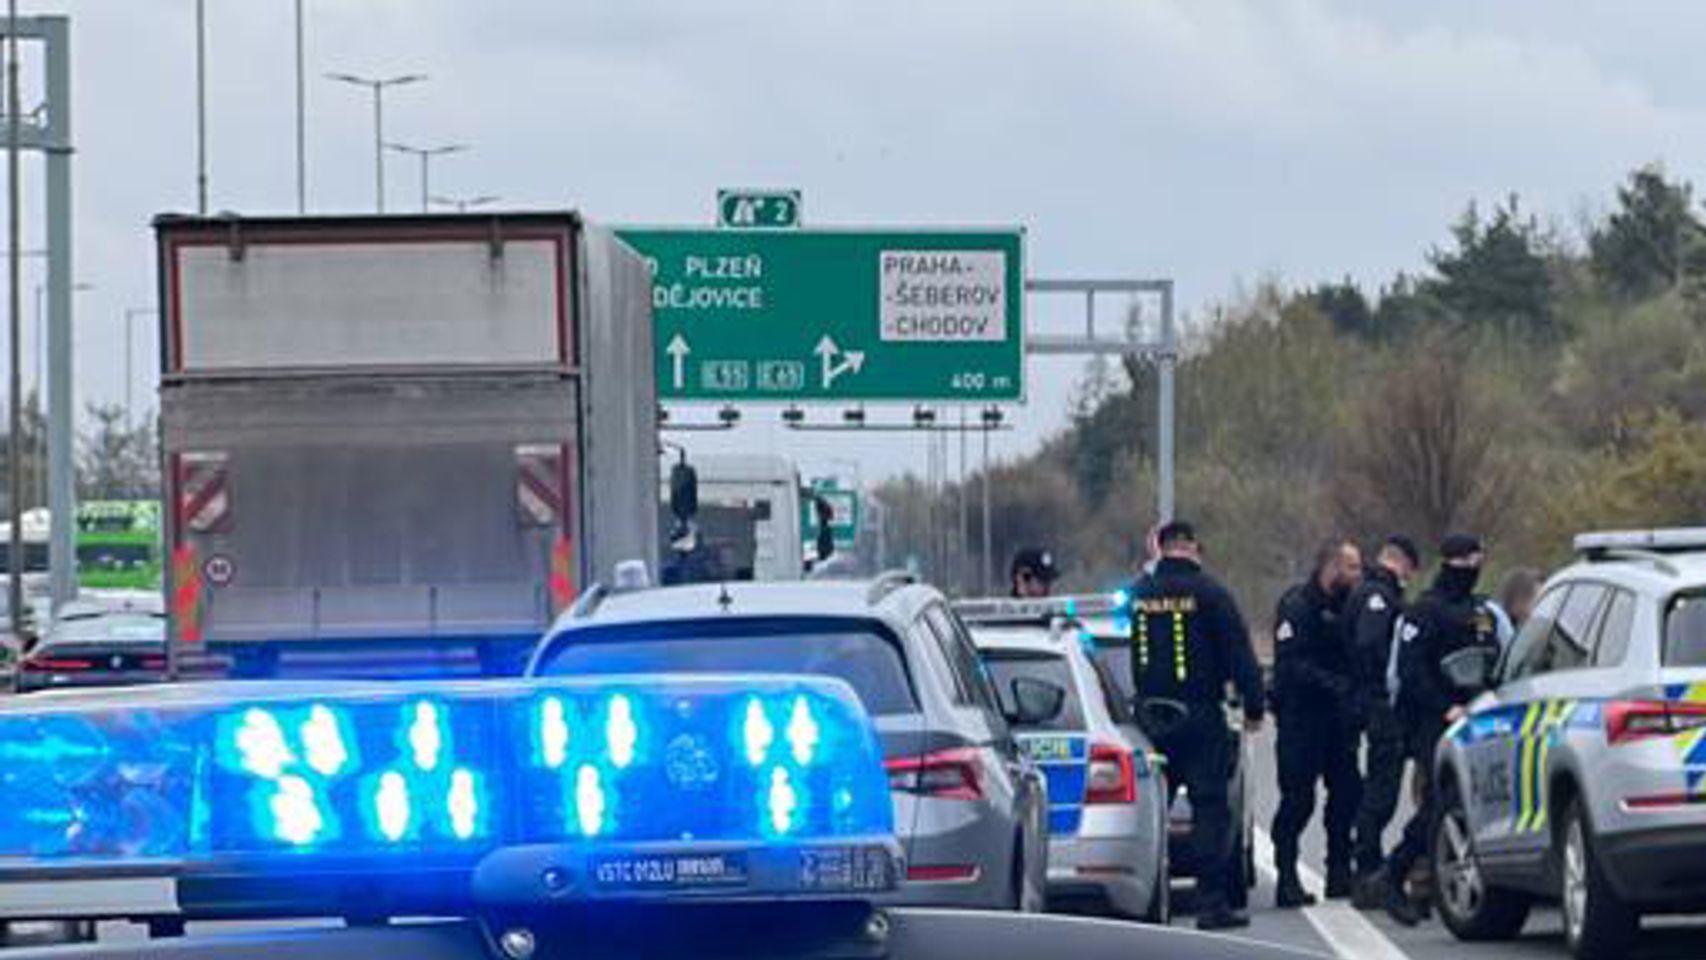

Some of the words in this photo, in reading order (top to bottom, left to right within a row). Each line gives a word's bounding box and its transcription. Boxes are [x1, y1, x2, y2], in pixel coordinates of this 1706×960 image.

[774, 200, 788, 221] 2
[685, 254, 762, 278] PLZEŇ
[951, 372, 985, 390] 400
[991, 375, 1012, 389] m
